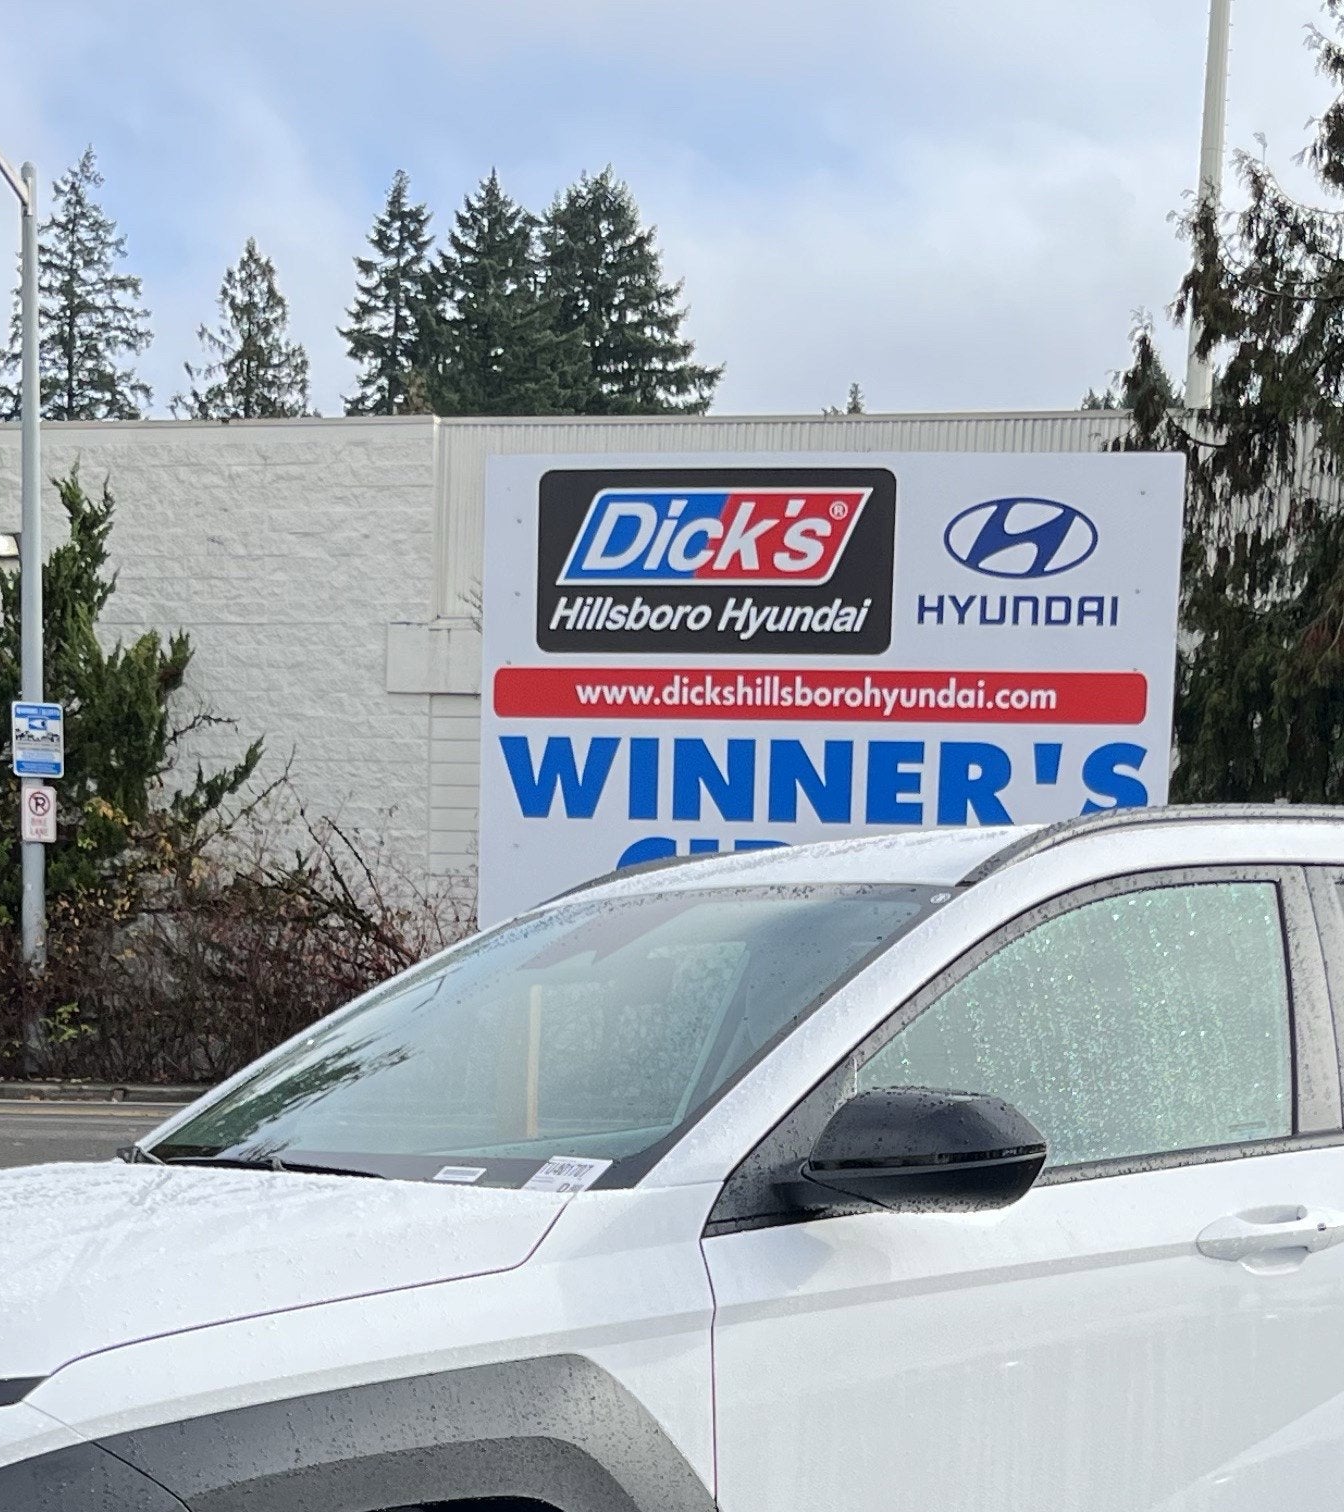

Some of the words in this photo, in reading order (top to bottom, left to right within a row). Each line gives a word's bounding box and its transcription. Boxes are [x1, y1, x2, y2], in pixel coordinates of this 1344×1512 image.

[549, 596, 712, 634] Hillsboro
[717, 598, 872, 640] Hyundai
[916, 594, 1119, 628] HYUNDAI
[575, 675, 1058, 718] www.dickshillsborohyundai.com
[499, 735, 1149, 826] WINNER'S
